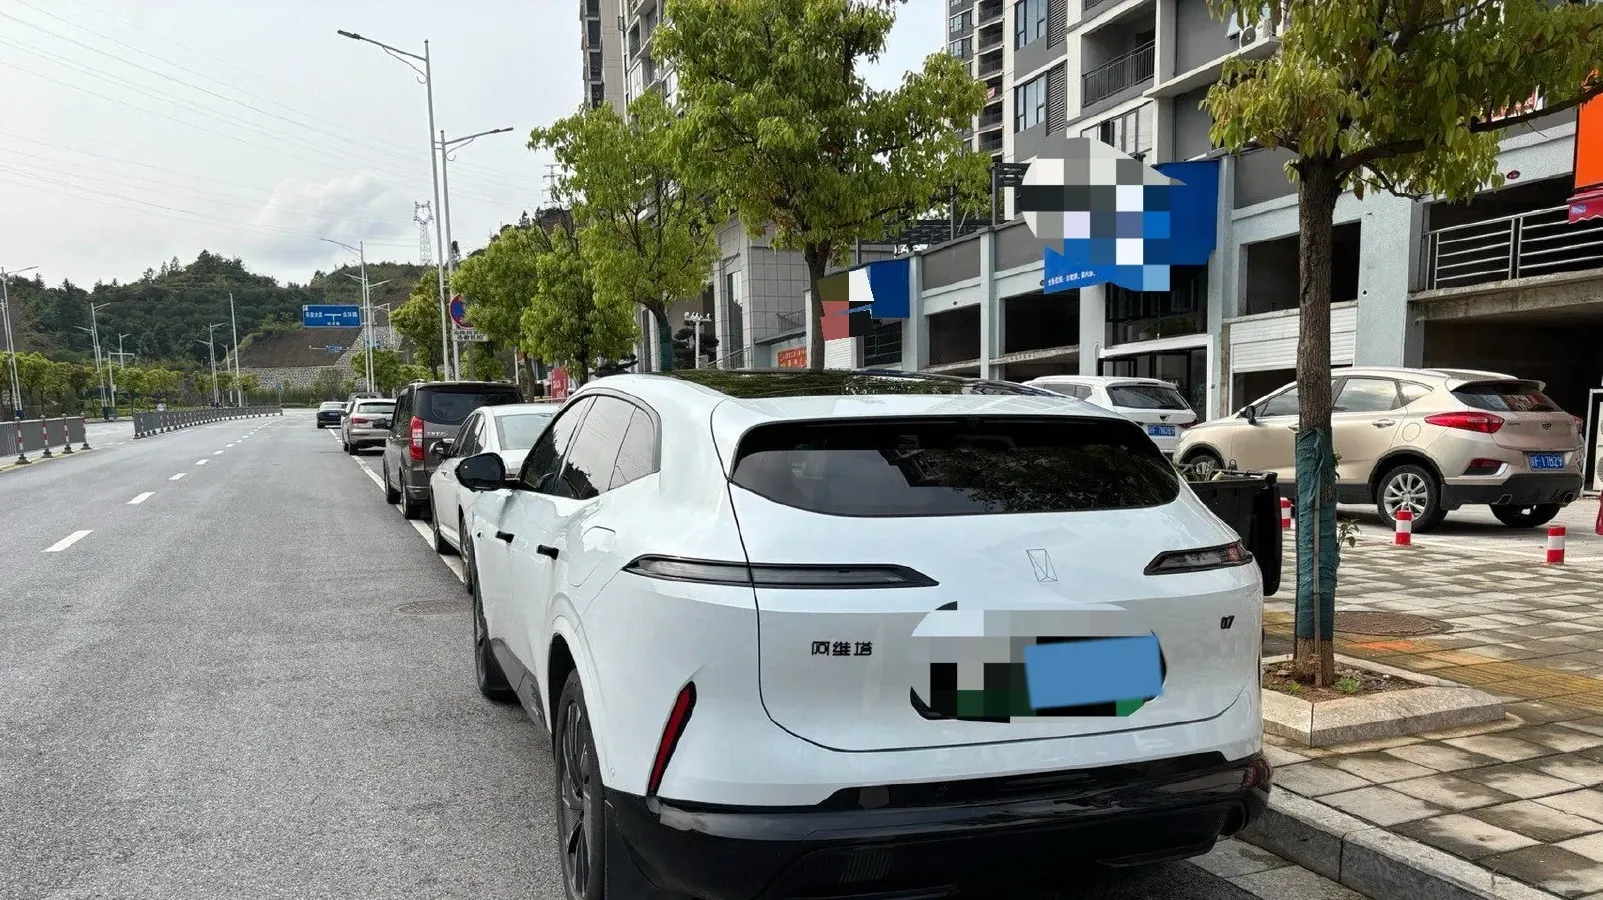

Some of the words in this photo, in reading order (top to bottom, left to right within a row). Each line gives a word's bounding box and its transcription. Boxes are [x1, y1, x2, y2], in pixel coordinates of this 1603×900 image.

[1220, 615, 1235, 629] 07
[811, 641, 873, 656] 阿维塔
